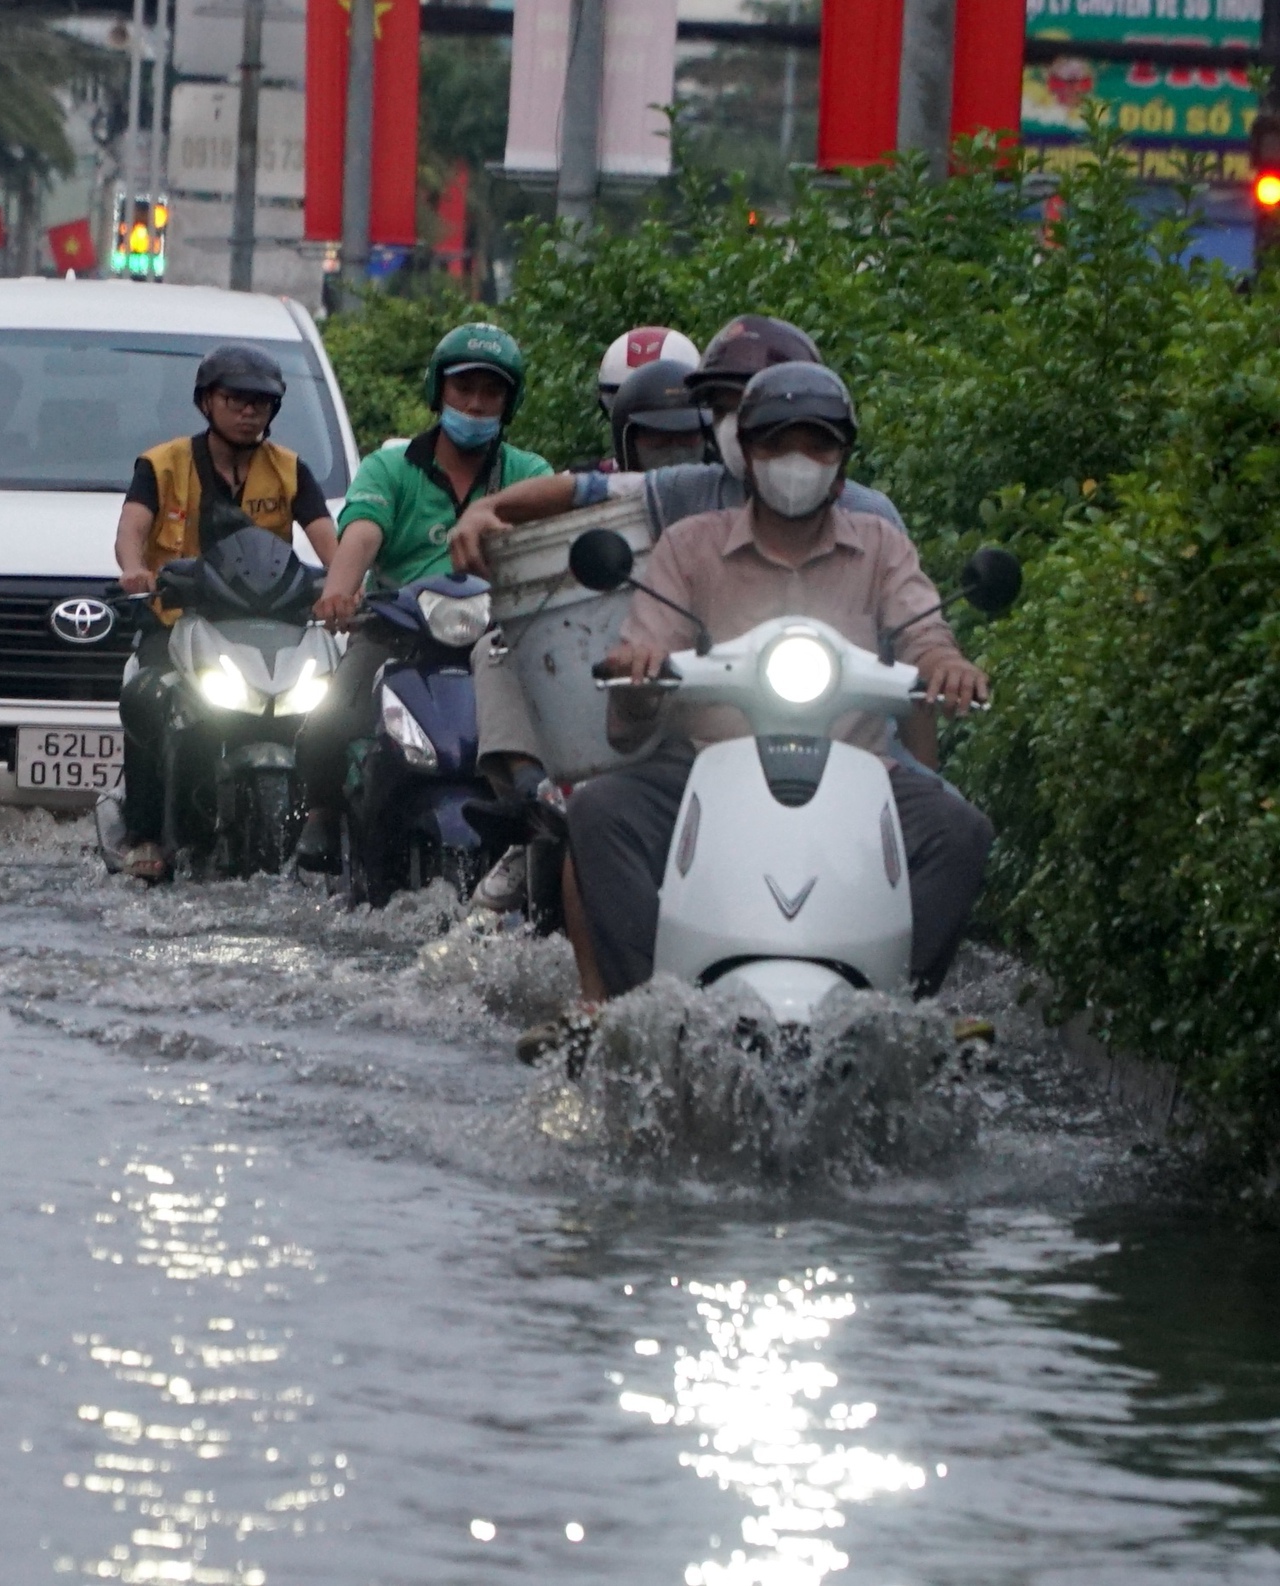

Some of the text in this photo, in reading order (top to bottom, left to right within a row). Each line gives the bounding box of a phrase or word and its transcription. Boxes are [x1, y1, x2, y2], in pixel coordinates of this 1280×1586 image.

[467, 338, 502, 355] Grab
[44, 732, 115, 759] 62LD
[30, 761, 124, 788] 019.57
